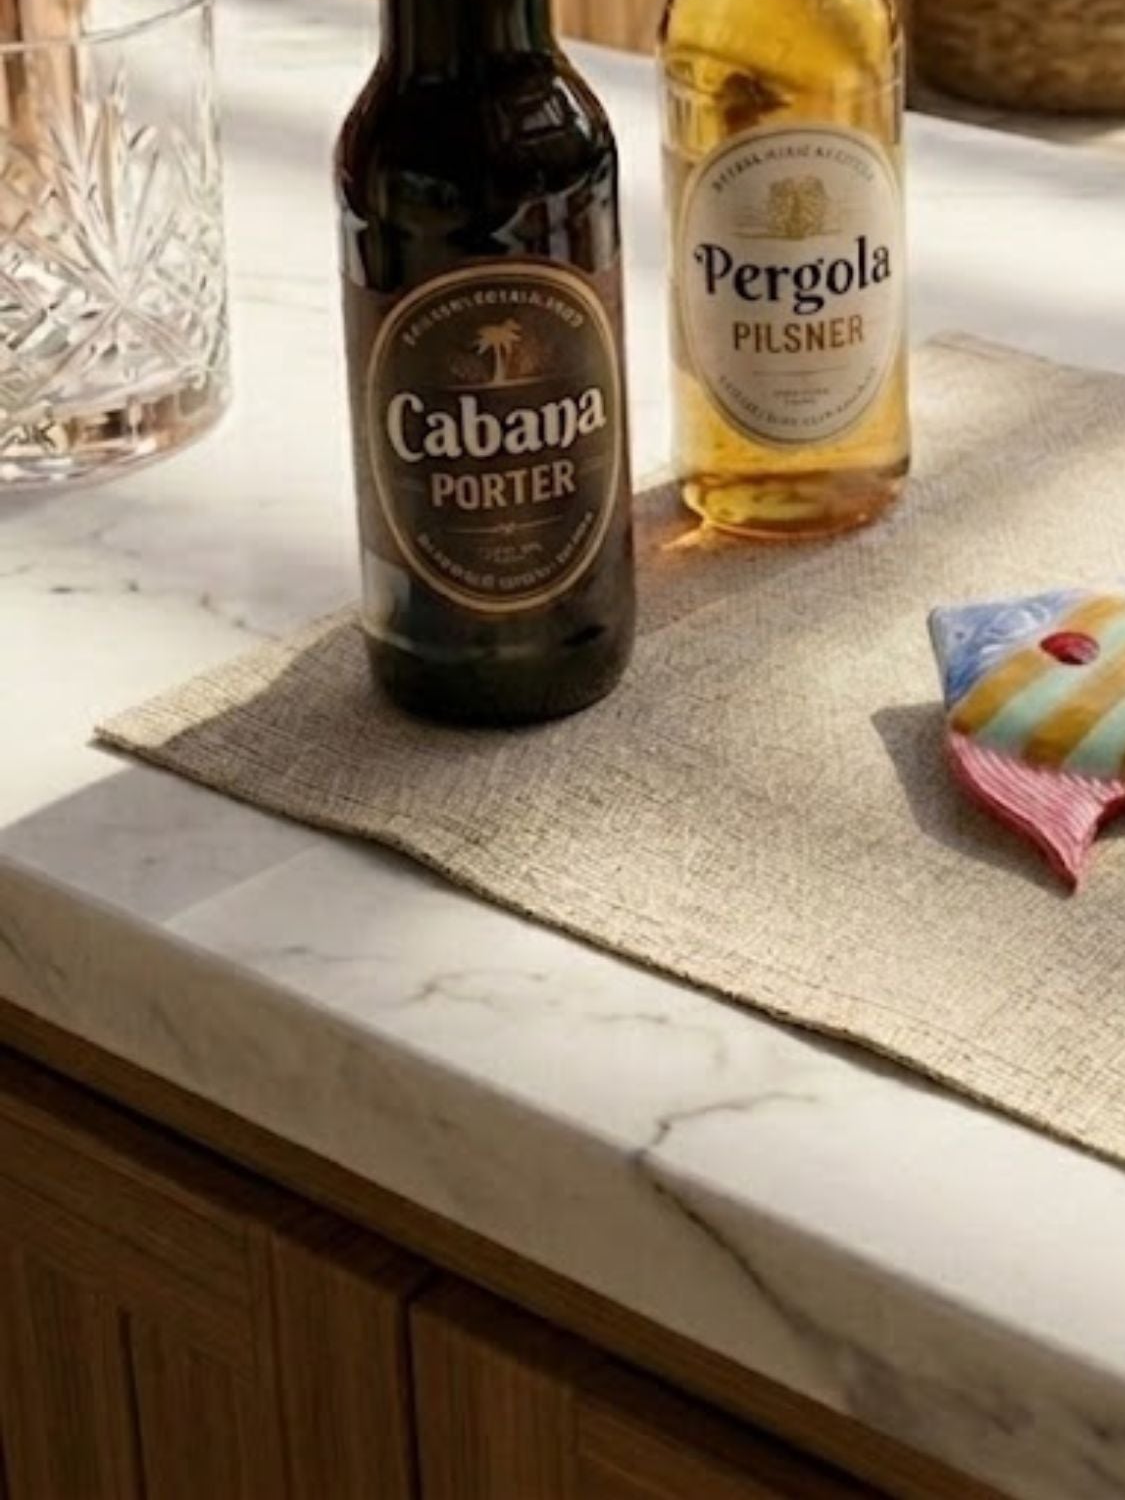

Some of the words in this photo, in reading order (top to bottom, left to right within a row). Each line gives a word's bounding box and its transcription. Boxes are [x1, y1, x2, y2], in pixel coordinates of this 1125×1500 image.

[693, 235, 892, 315] Pergola
[732, 314, 864, 354] PILSNER
[386, 387, 607, 463] Cabana
[431, 458, 576, 510] PORTER
